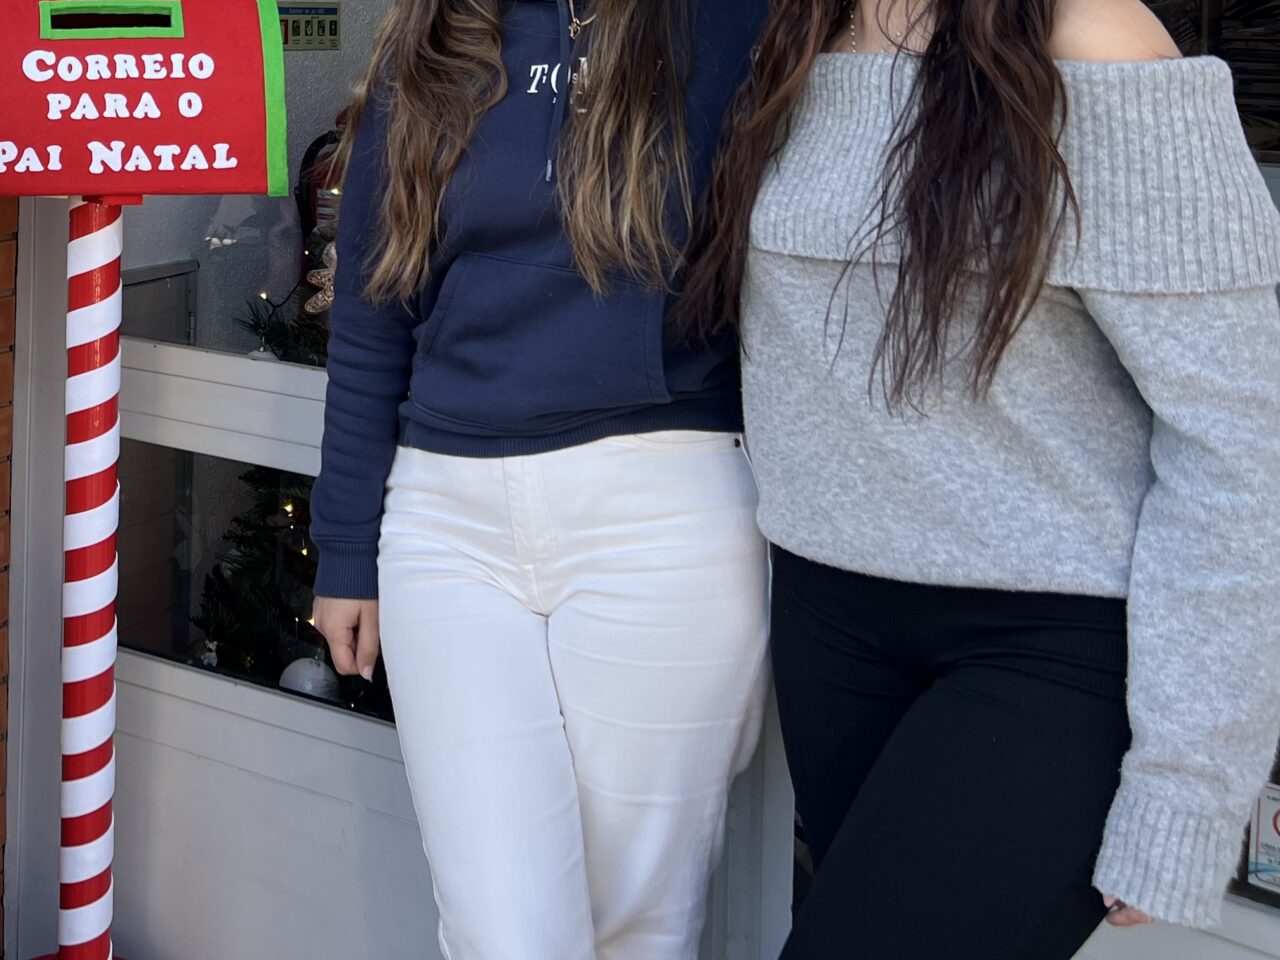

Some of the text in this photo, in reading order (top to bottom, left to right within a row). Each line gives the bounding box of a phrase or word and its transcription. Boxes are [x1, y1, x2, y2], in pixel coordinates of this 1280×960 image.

[22, 49, 215, 82] CORREIO
[46, 92, 203, 120] PARA O
[87, 140, 238, 174] NATAL
